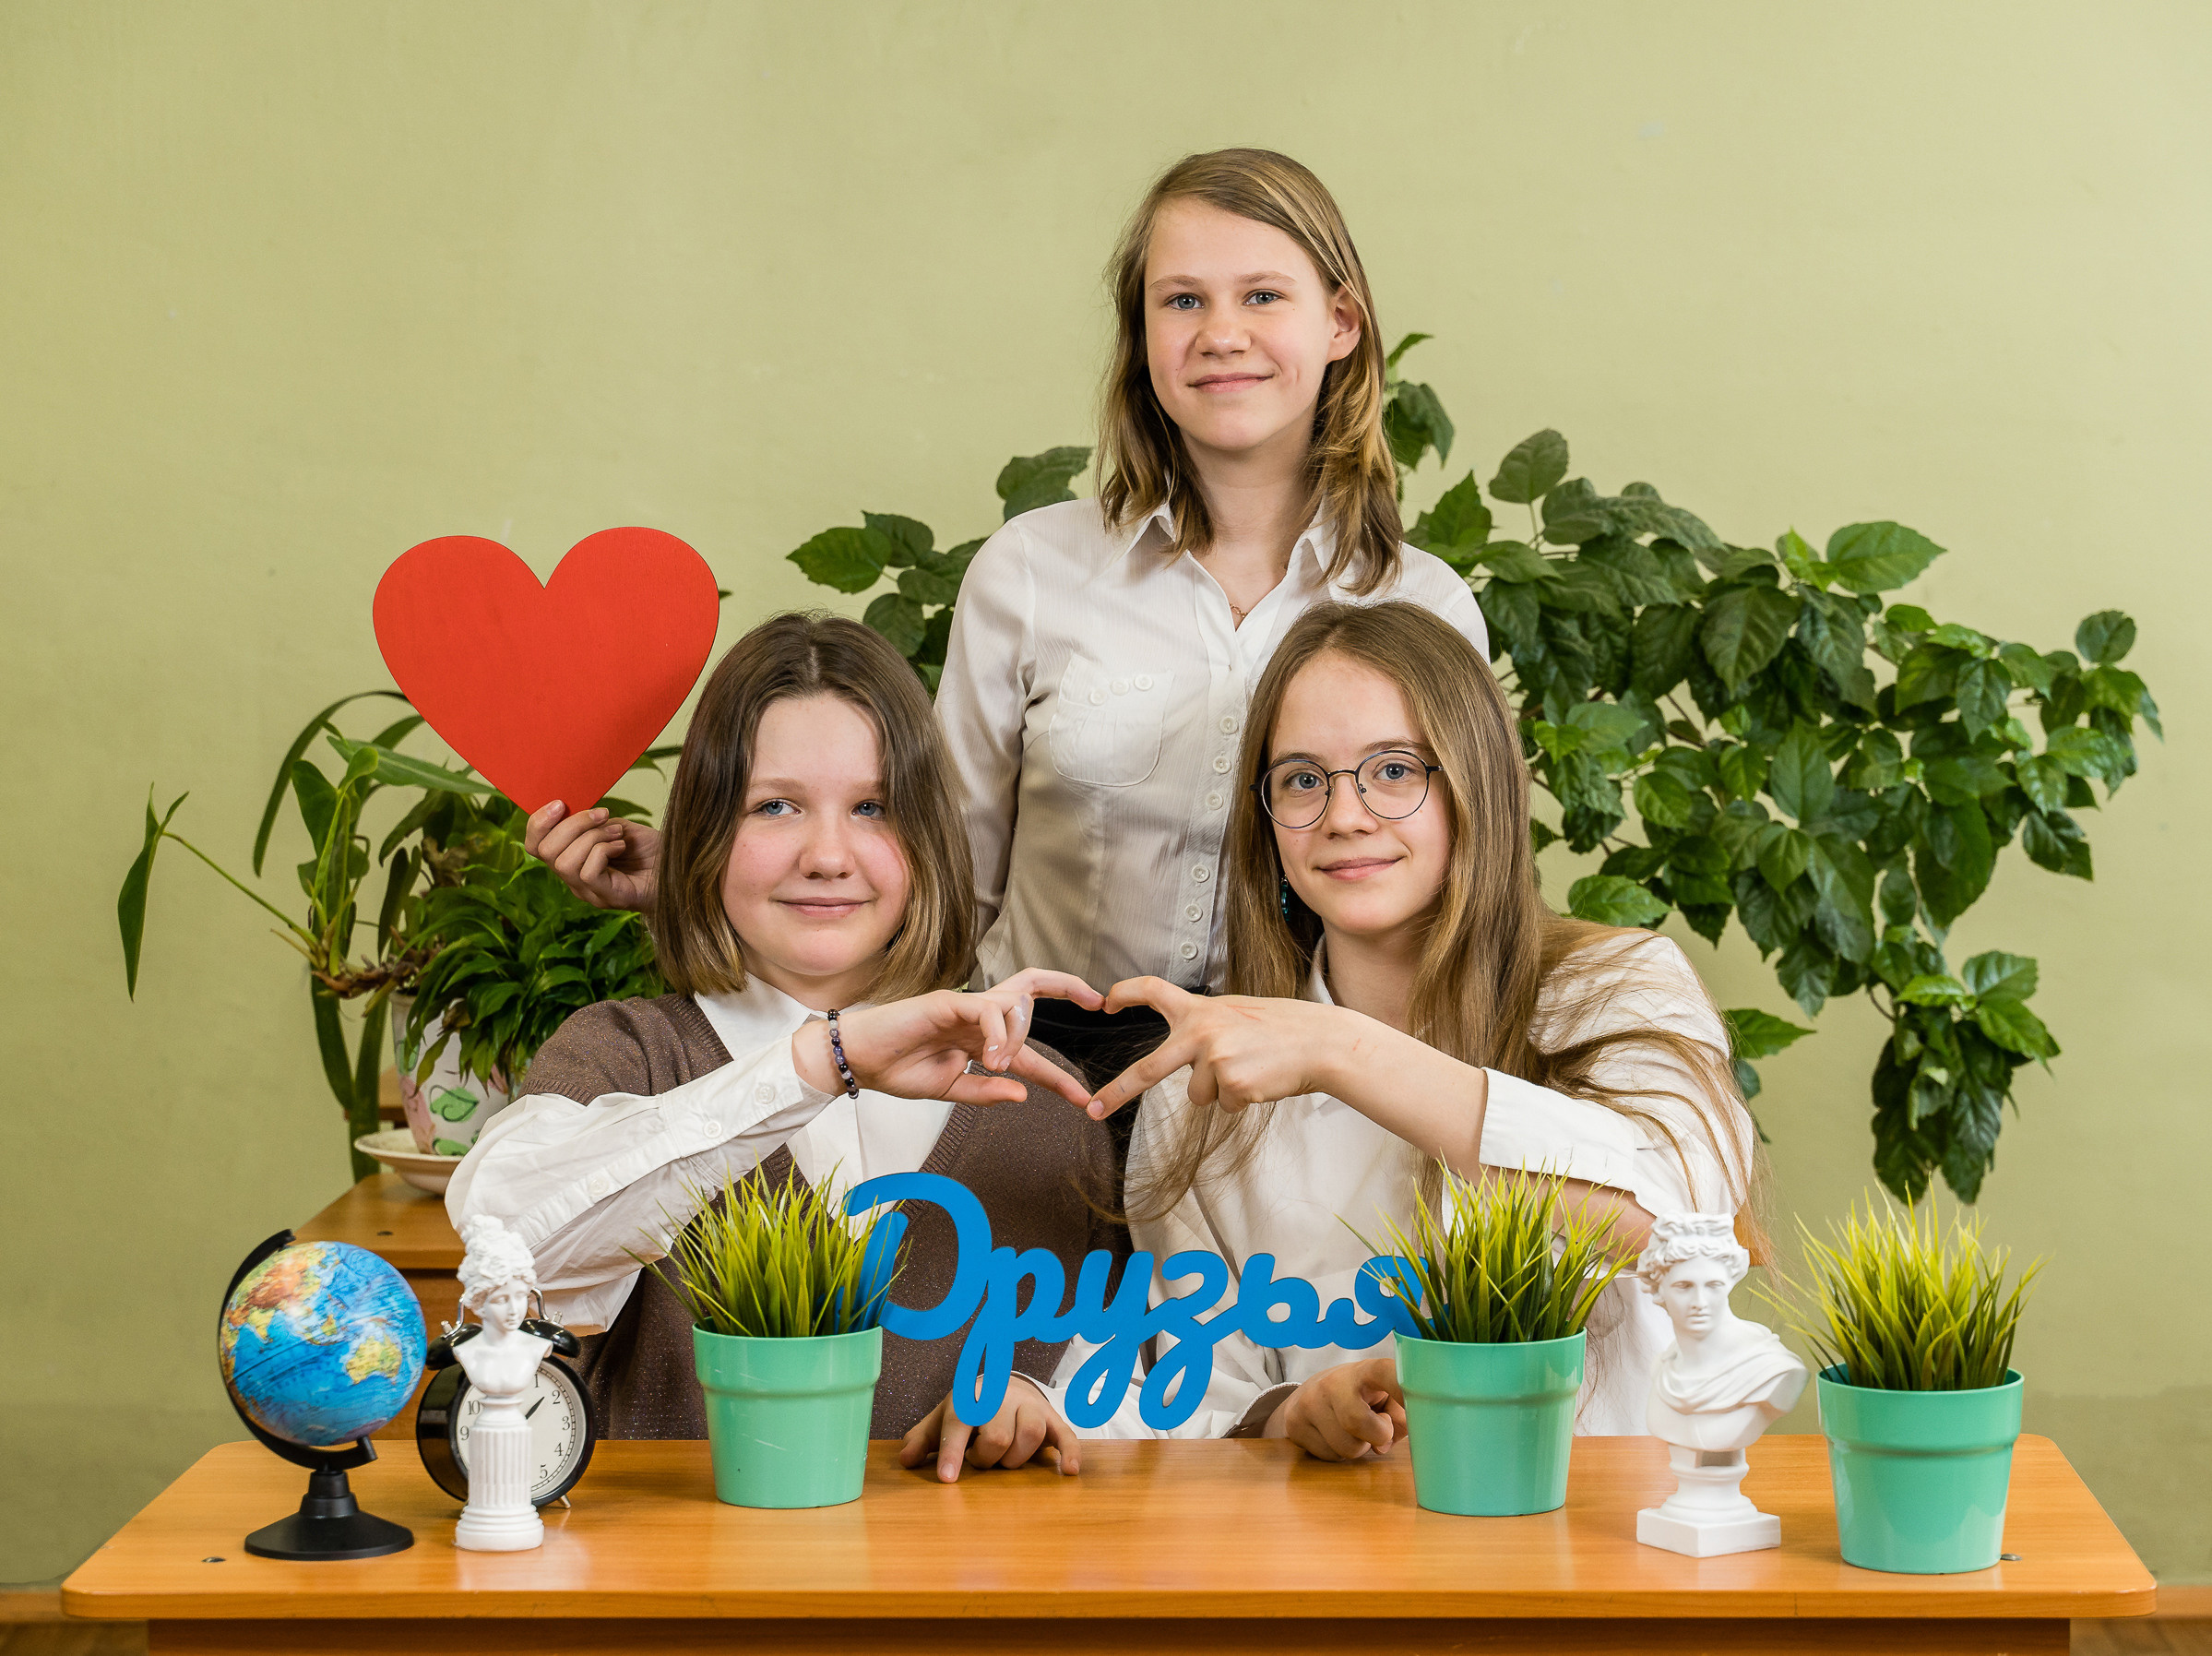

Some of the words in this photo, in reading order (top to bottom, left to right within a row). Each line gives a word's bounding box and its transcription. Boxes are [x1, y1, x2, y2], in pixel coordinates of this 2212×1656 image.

[830, 1172, 1444, 1430] Друзья
[552, 1389, 561, 1405] 2
[468, 1400, 481, 1415] 10
[562, 1416, 570, 1431] 3
[460, 1425, 470, 1441] 9
[553, 1442, 564, 1456] 4
[540, 1464, 548, 1479] 5
